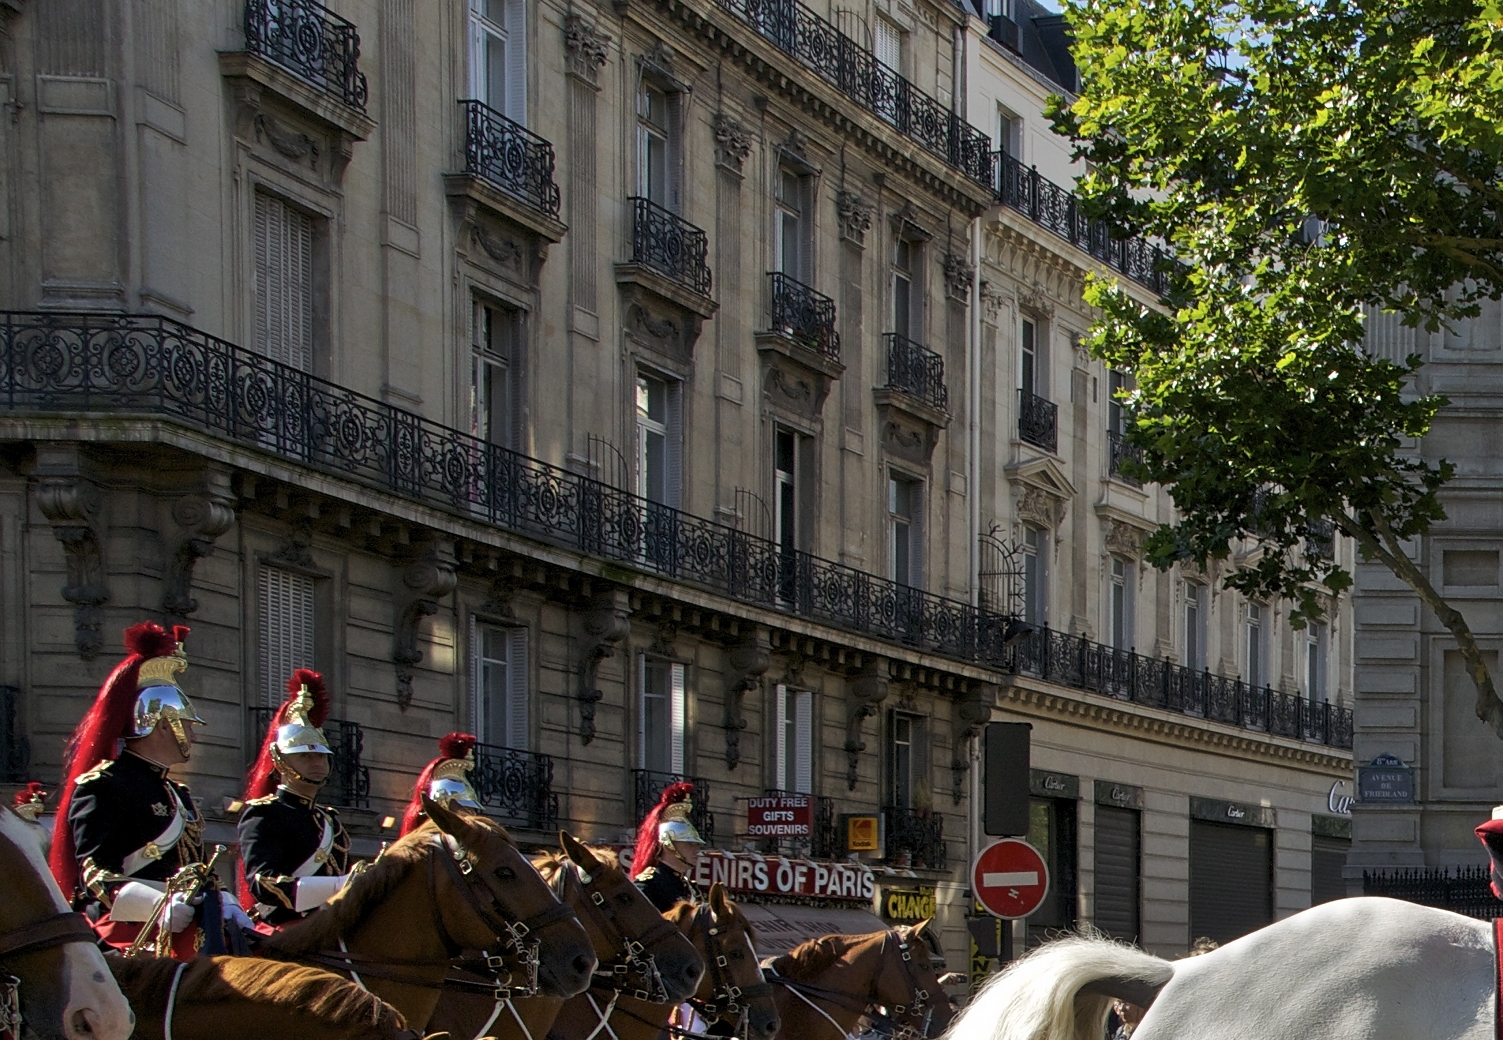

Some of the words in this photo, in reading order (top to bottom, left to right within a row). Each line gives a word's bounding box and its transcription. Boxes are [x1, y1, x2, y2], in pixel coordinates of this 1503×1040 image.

[1045, 776, 1065, 790] Cartier
[1112, 788, 1130, 801] Cartier
[749, 798, 778, 808] DUTY
[781, 798, 808, 808] FREE
[763, 811, 795, 821] GIFTS
[1227, 805, 1245, 818] Cartier
[748, 824, 809, 835] SOUVENIRS
[776, 866, 808, 893] OF
[815, 867, 875, 899] PARIS
[888, 894, 936, 919] CHANGE
